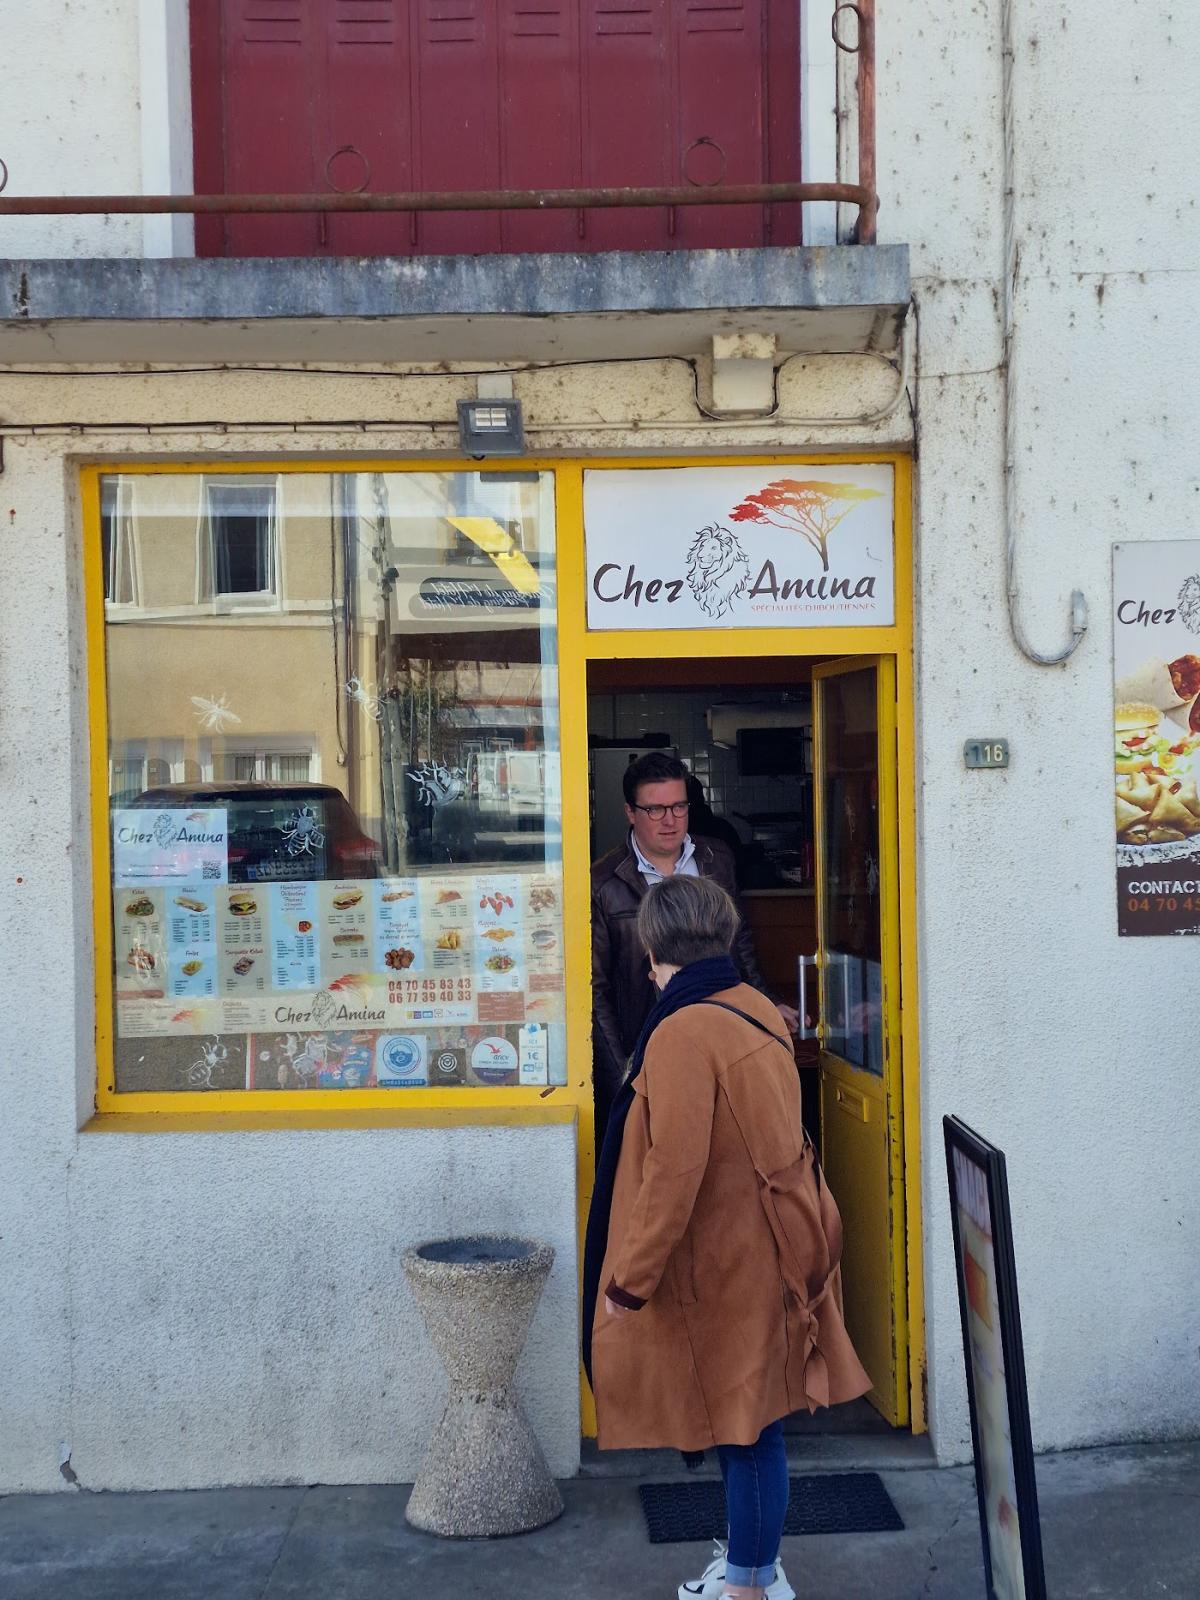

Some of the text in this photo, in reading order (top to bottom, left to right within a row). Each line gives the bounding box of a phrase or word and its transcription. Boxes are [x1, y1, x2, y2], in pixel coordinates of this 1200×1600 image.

[592, 559, 876, 607] Chez Amina
[1117, 600, 1177, 627] Chez
[118, 827, 224, 844] Chez Amina
[1128, 898, 1150, 912] 04
[1156, 897, 1178, 912] 70
[388, 980, 402, 992] 04
[405, 979, 418, 991] 70
[422, 979, 435, 991] 45
[440, 978, 453, 990] 83
[457, 978, 471, 989] 43
[388, 990, 471, 1004] 06 77 39 40 33
[275, 1006, 311, 1024] Chez
[336, 1004, 385, 1021] Amina
